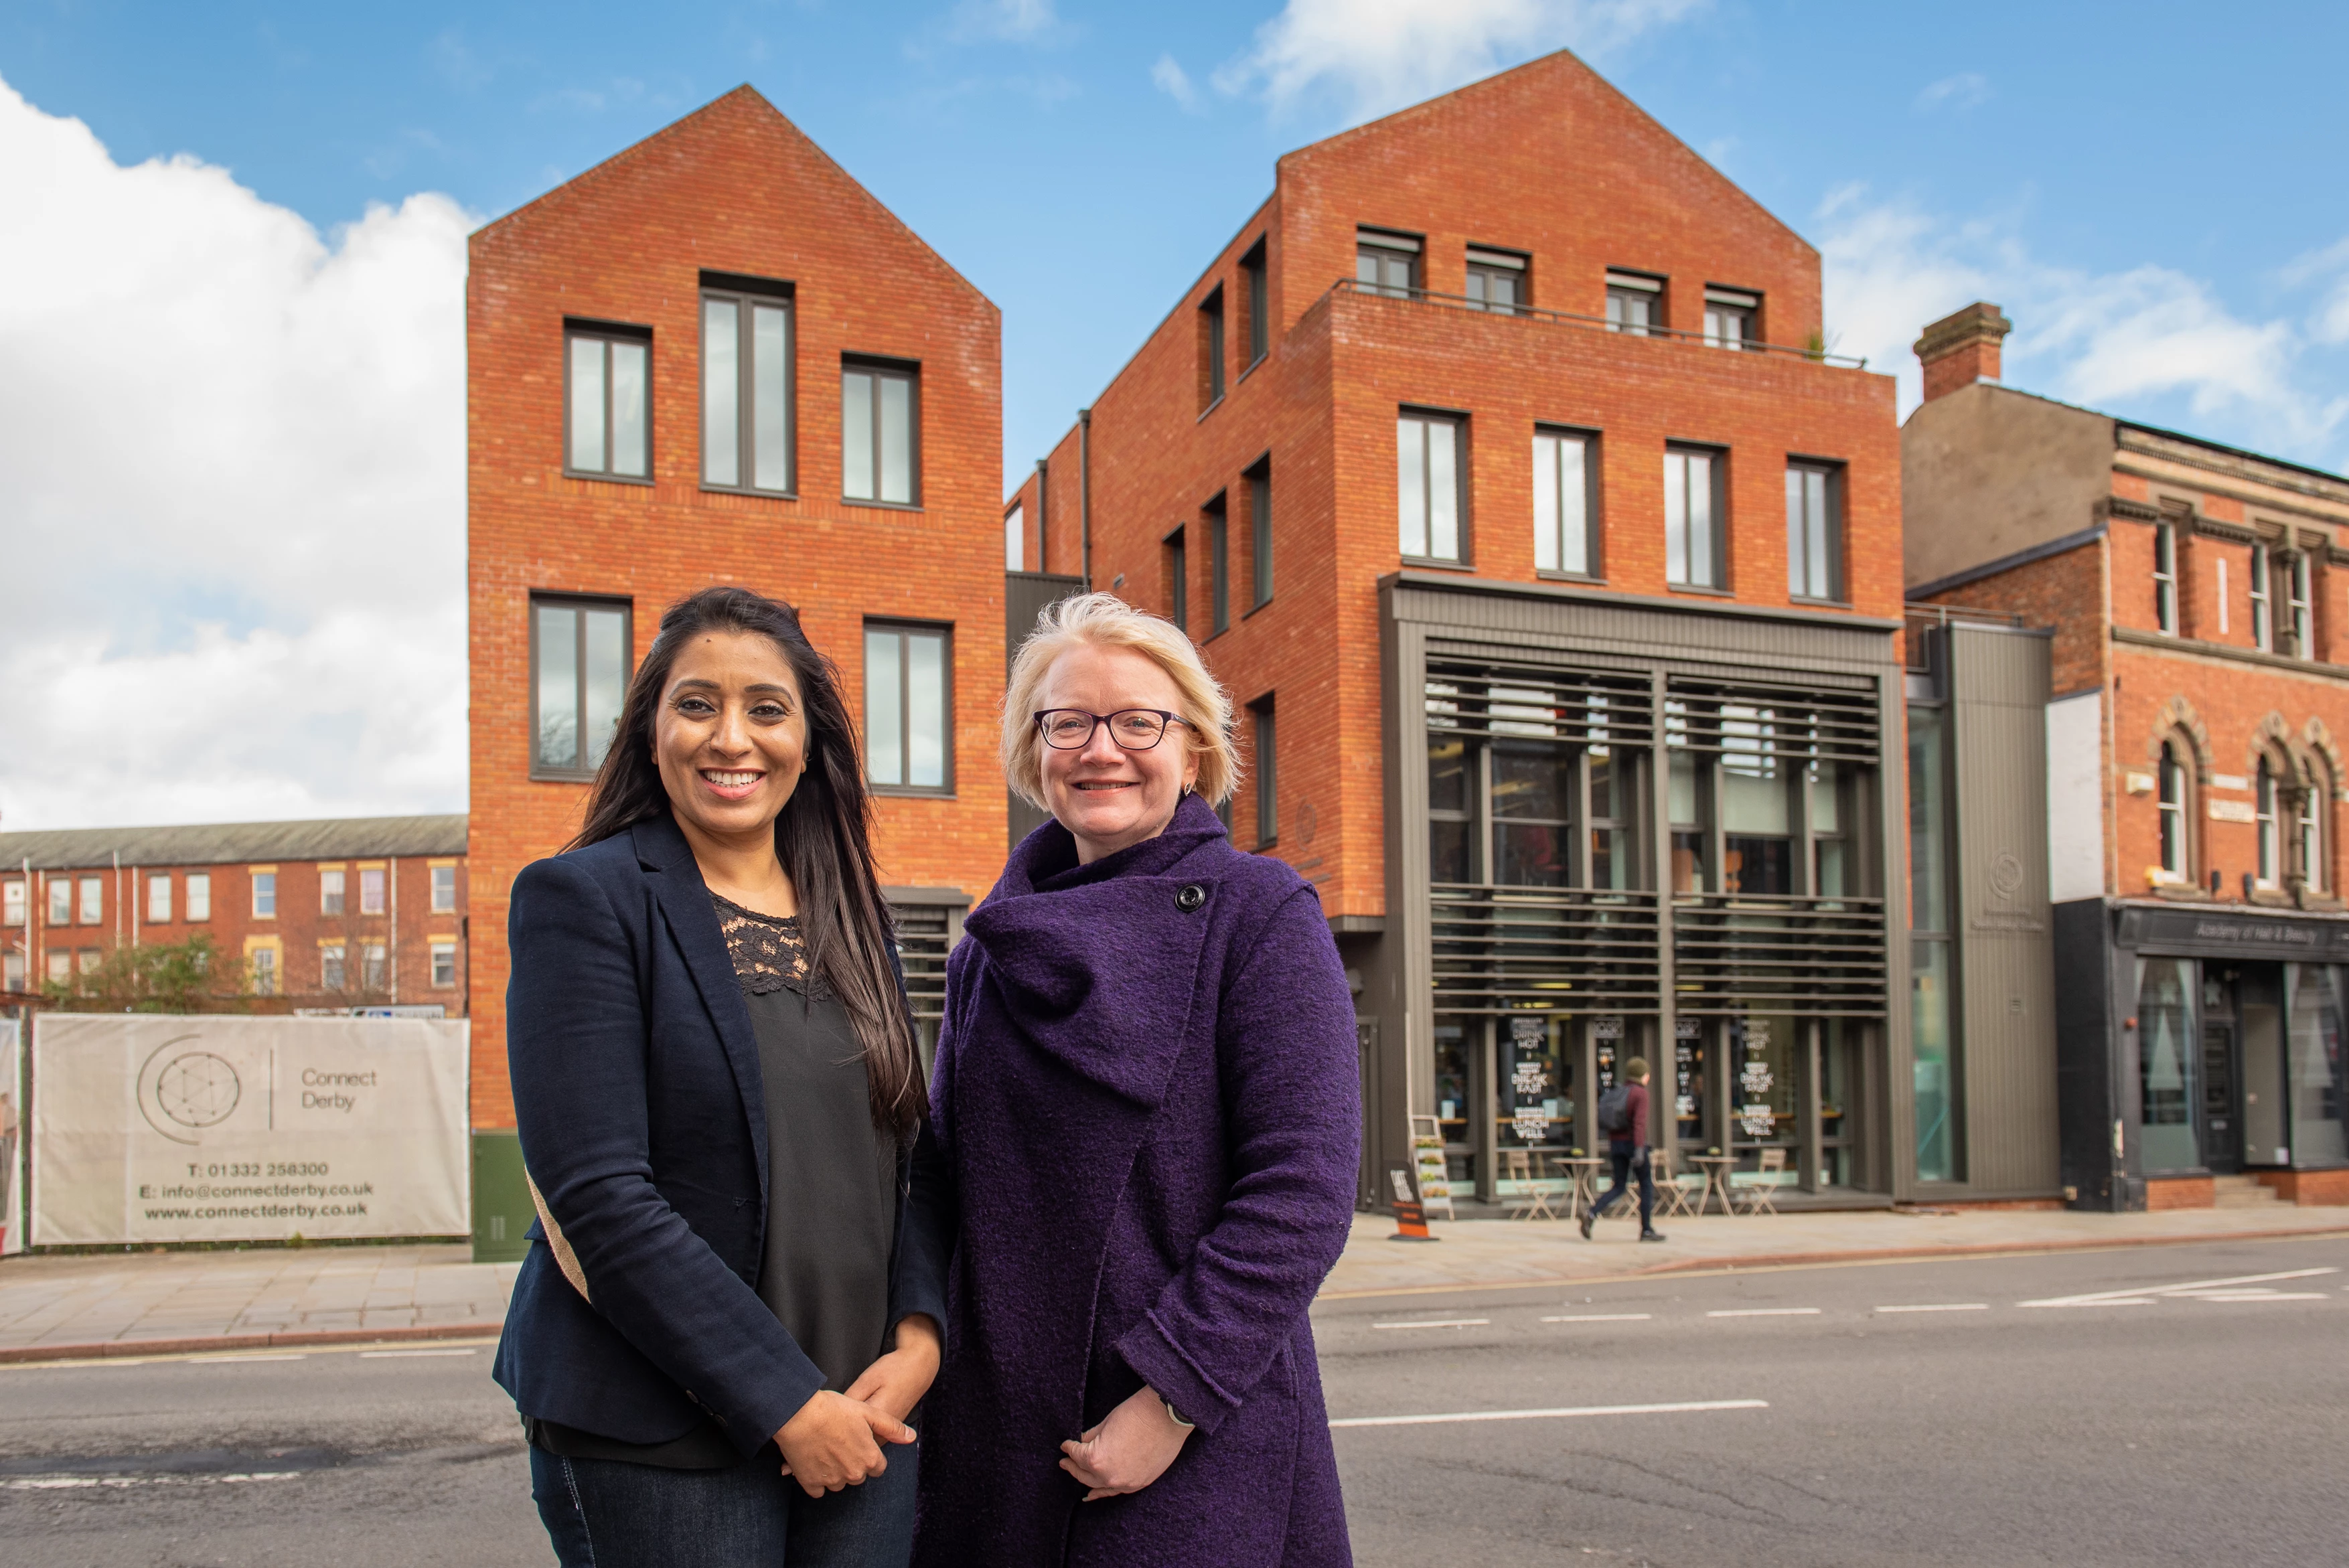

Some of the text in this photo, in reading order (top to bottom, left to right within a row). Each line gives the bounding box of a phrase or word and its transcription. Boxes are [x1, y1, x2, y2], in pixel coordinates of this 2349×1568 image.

[301, 1067, 378, 1087] Connect
[301, 1091, 356, 1114] Derby
[208, 1163, 261, 1178] 01332
[139, 1182, 374, 1200] E: info@connectderby.co.uk
[145, 1202, 368, 1220] www.connectderby.co.uk
